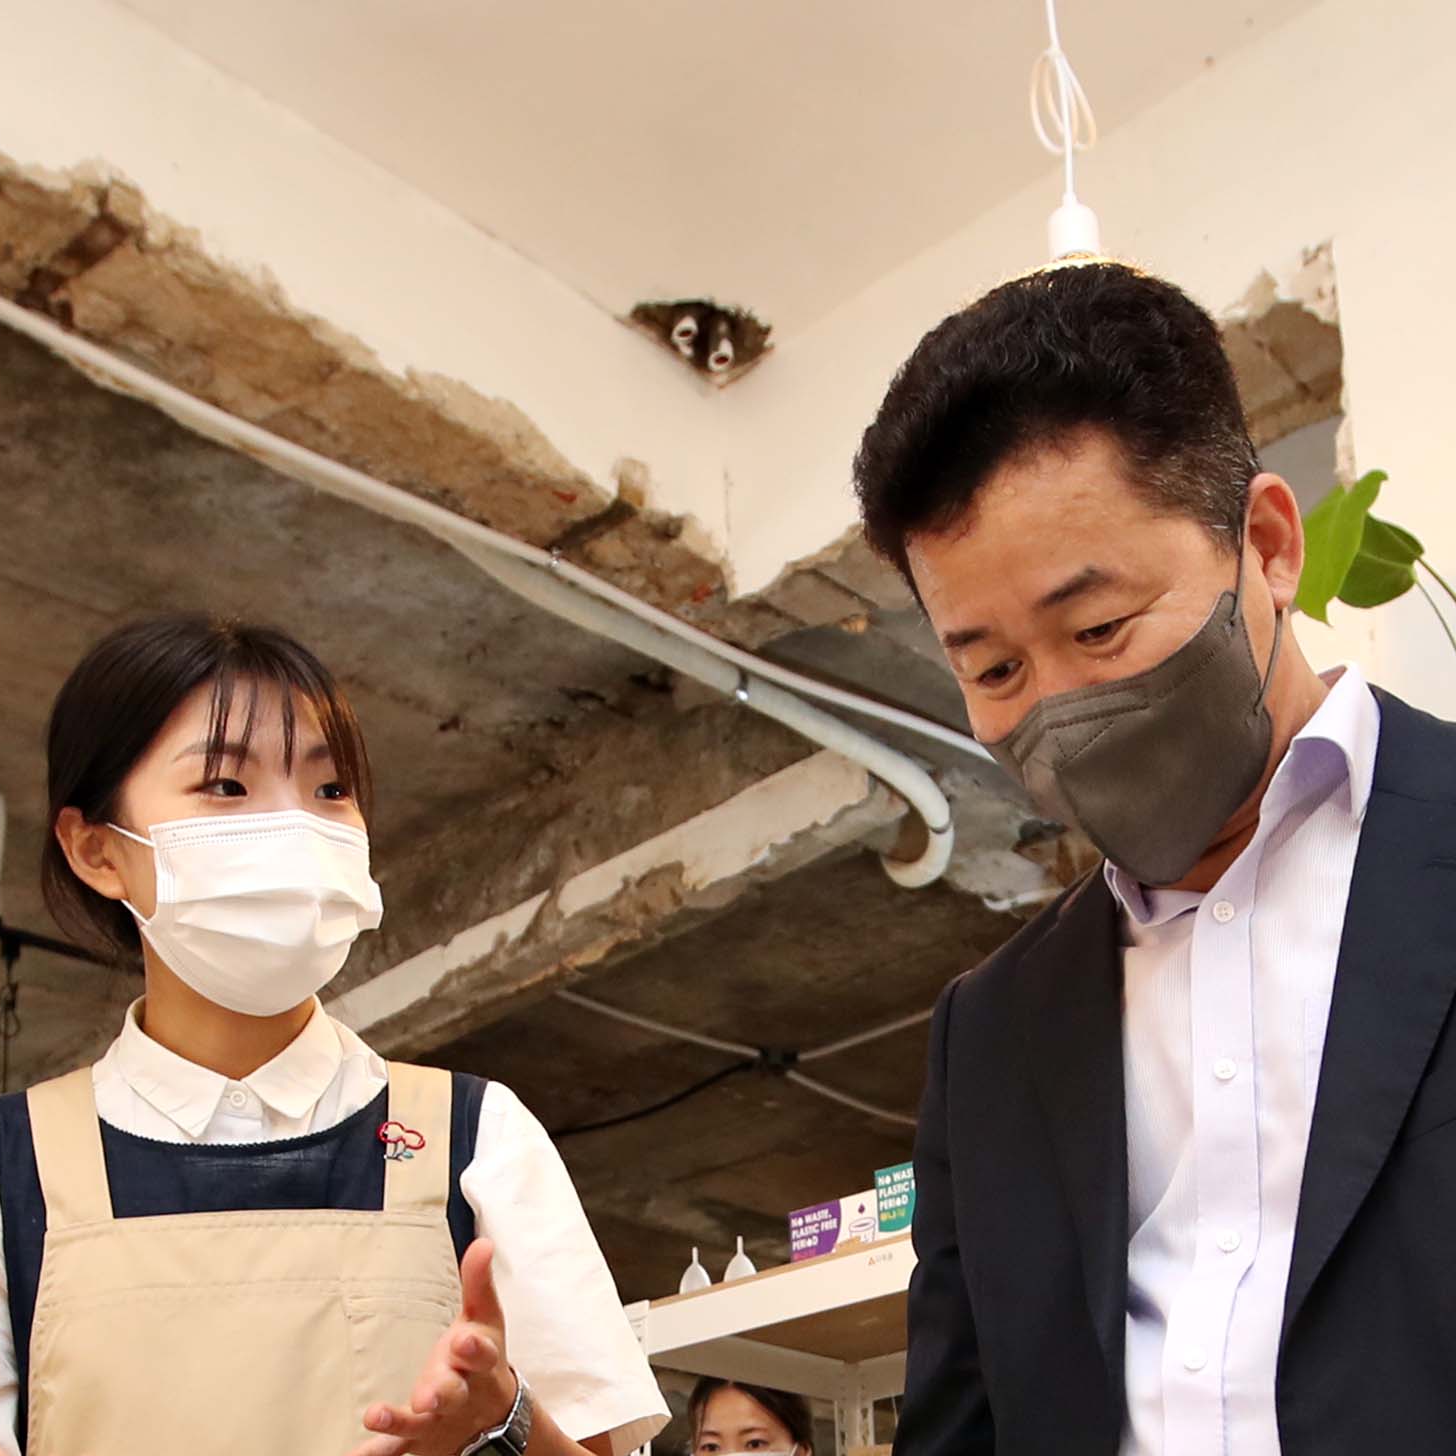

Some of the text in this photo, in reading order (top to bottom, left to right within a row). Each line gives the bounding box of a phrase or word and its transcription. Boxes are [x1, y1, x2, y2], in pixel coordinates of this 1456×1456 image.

[879, 1181, 910, 1199] PLASTIC
[791, 1217, 838, 1240] PLASTIC FREE
